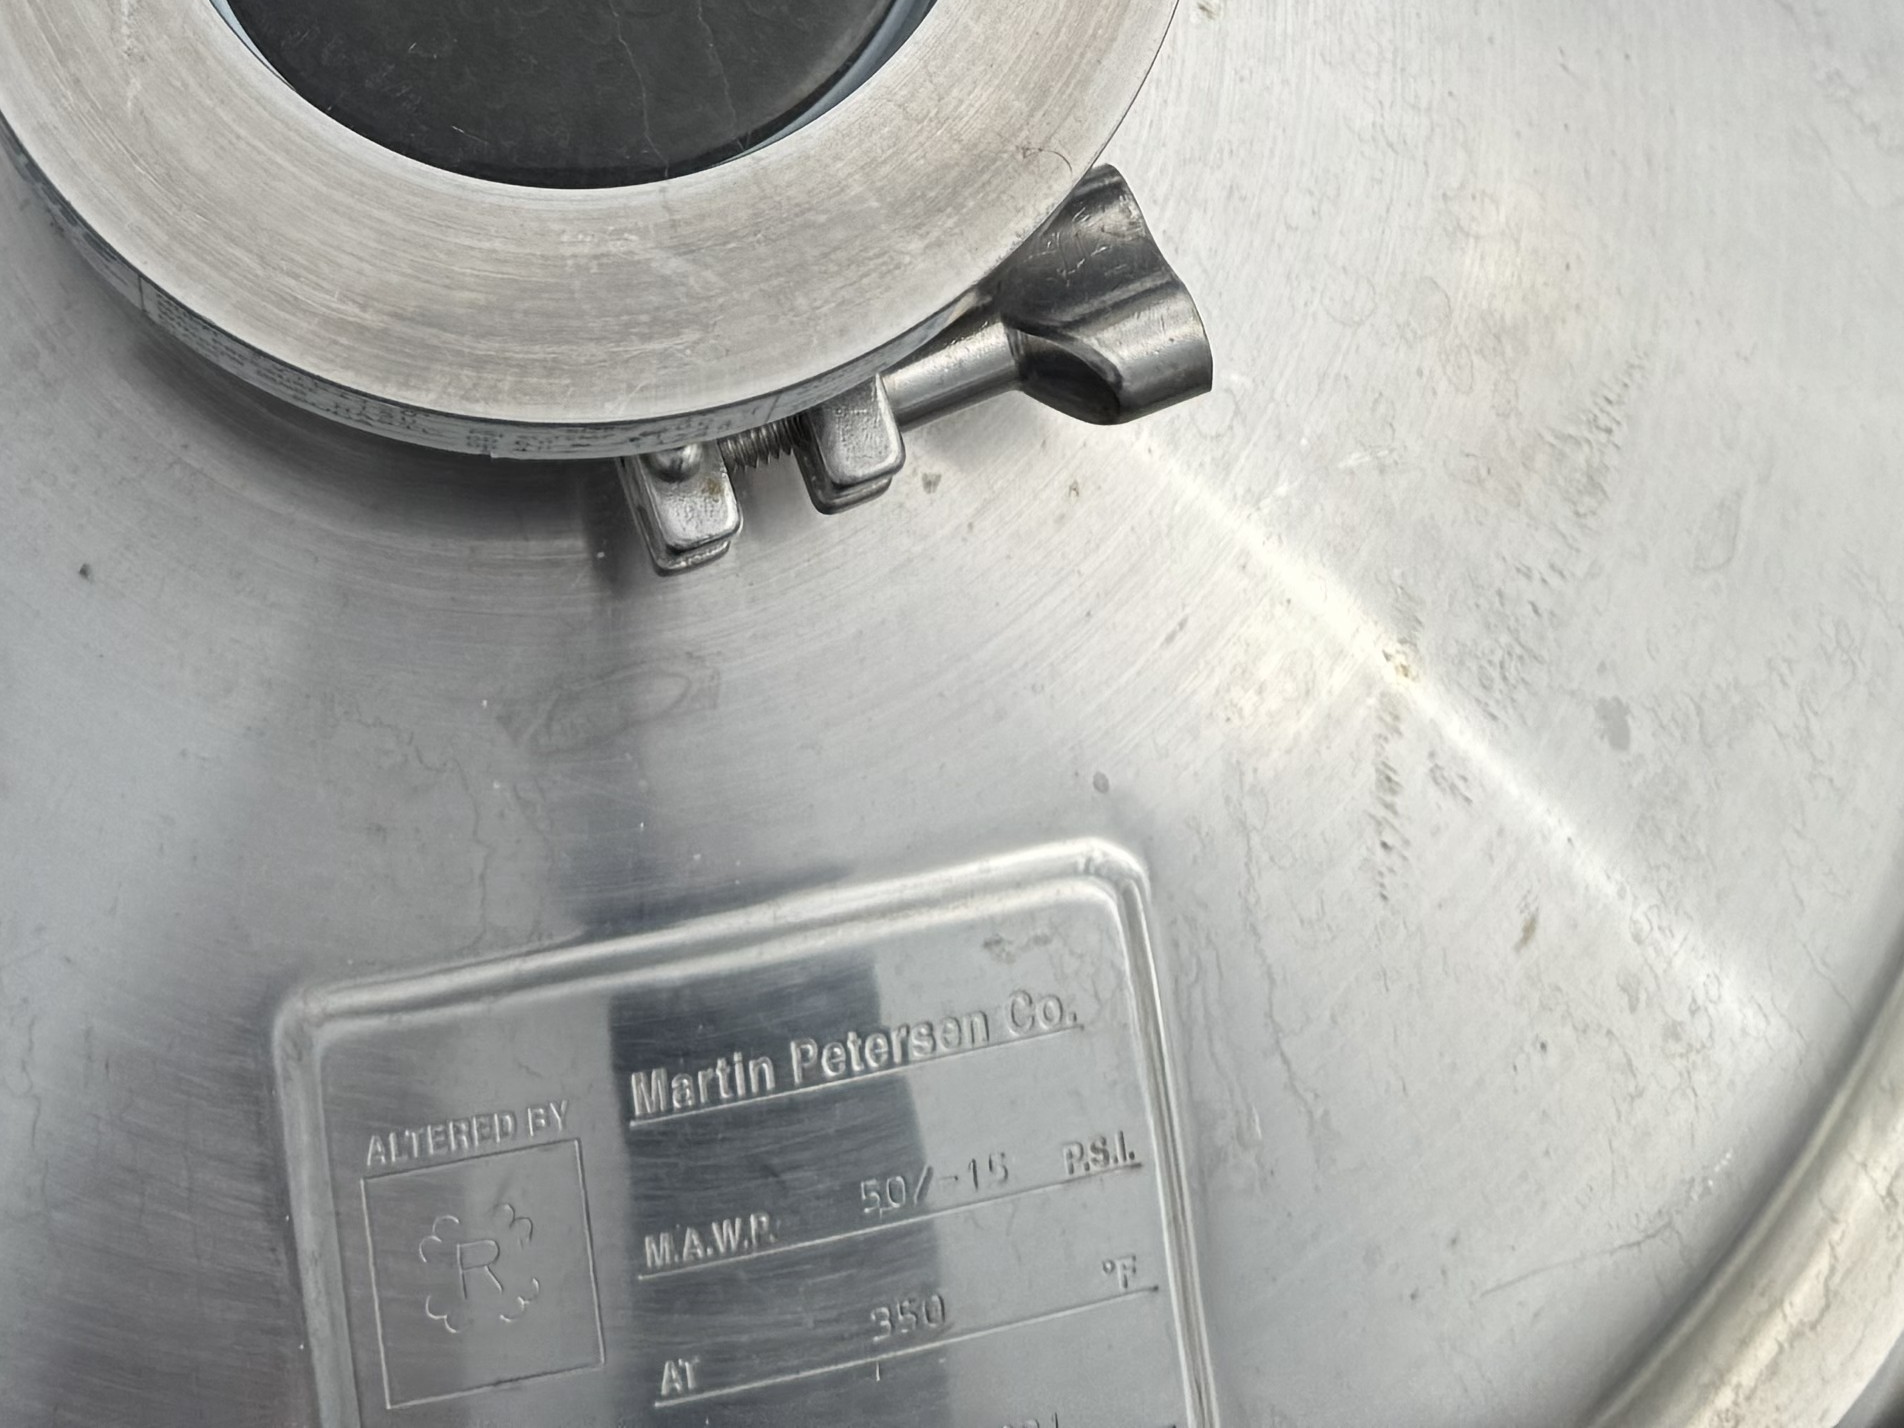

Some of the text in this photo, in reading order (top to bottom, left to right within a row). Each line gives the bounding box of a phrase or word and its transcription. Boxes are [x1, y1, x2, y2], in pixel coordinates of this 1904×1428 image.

[630, 989, 1079, 1117] Martin Petersen Co.
[366, 1098, 571, 1167] ALTERED BY
[643, 1211, 780, 1269] M.A.W.P.
[1062, 1129, 1137, 1177] P.S.I.
[660, 1357, 700, 1397] AT
[869, 1293, 947, 1342] 350
